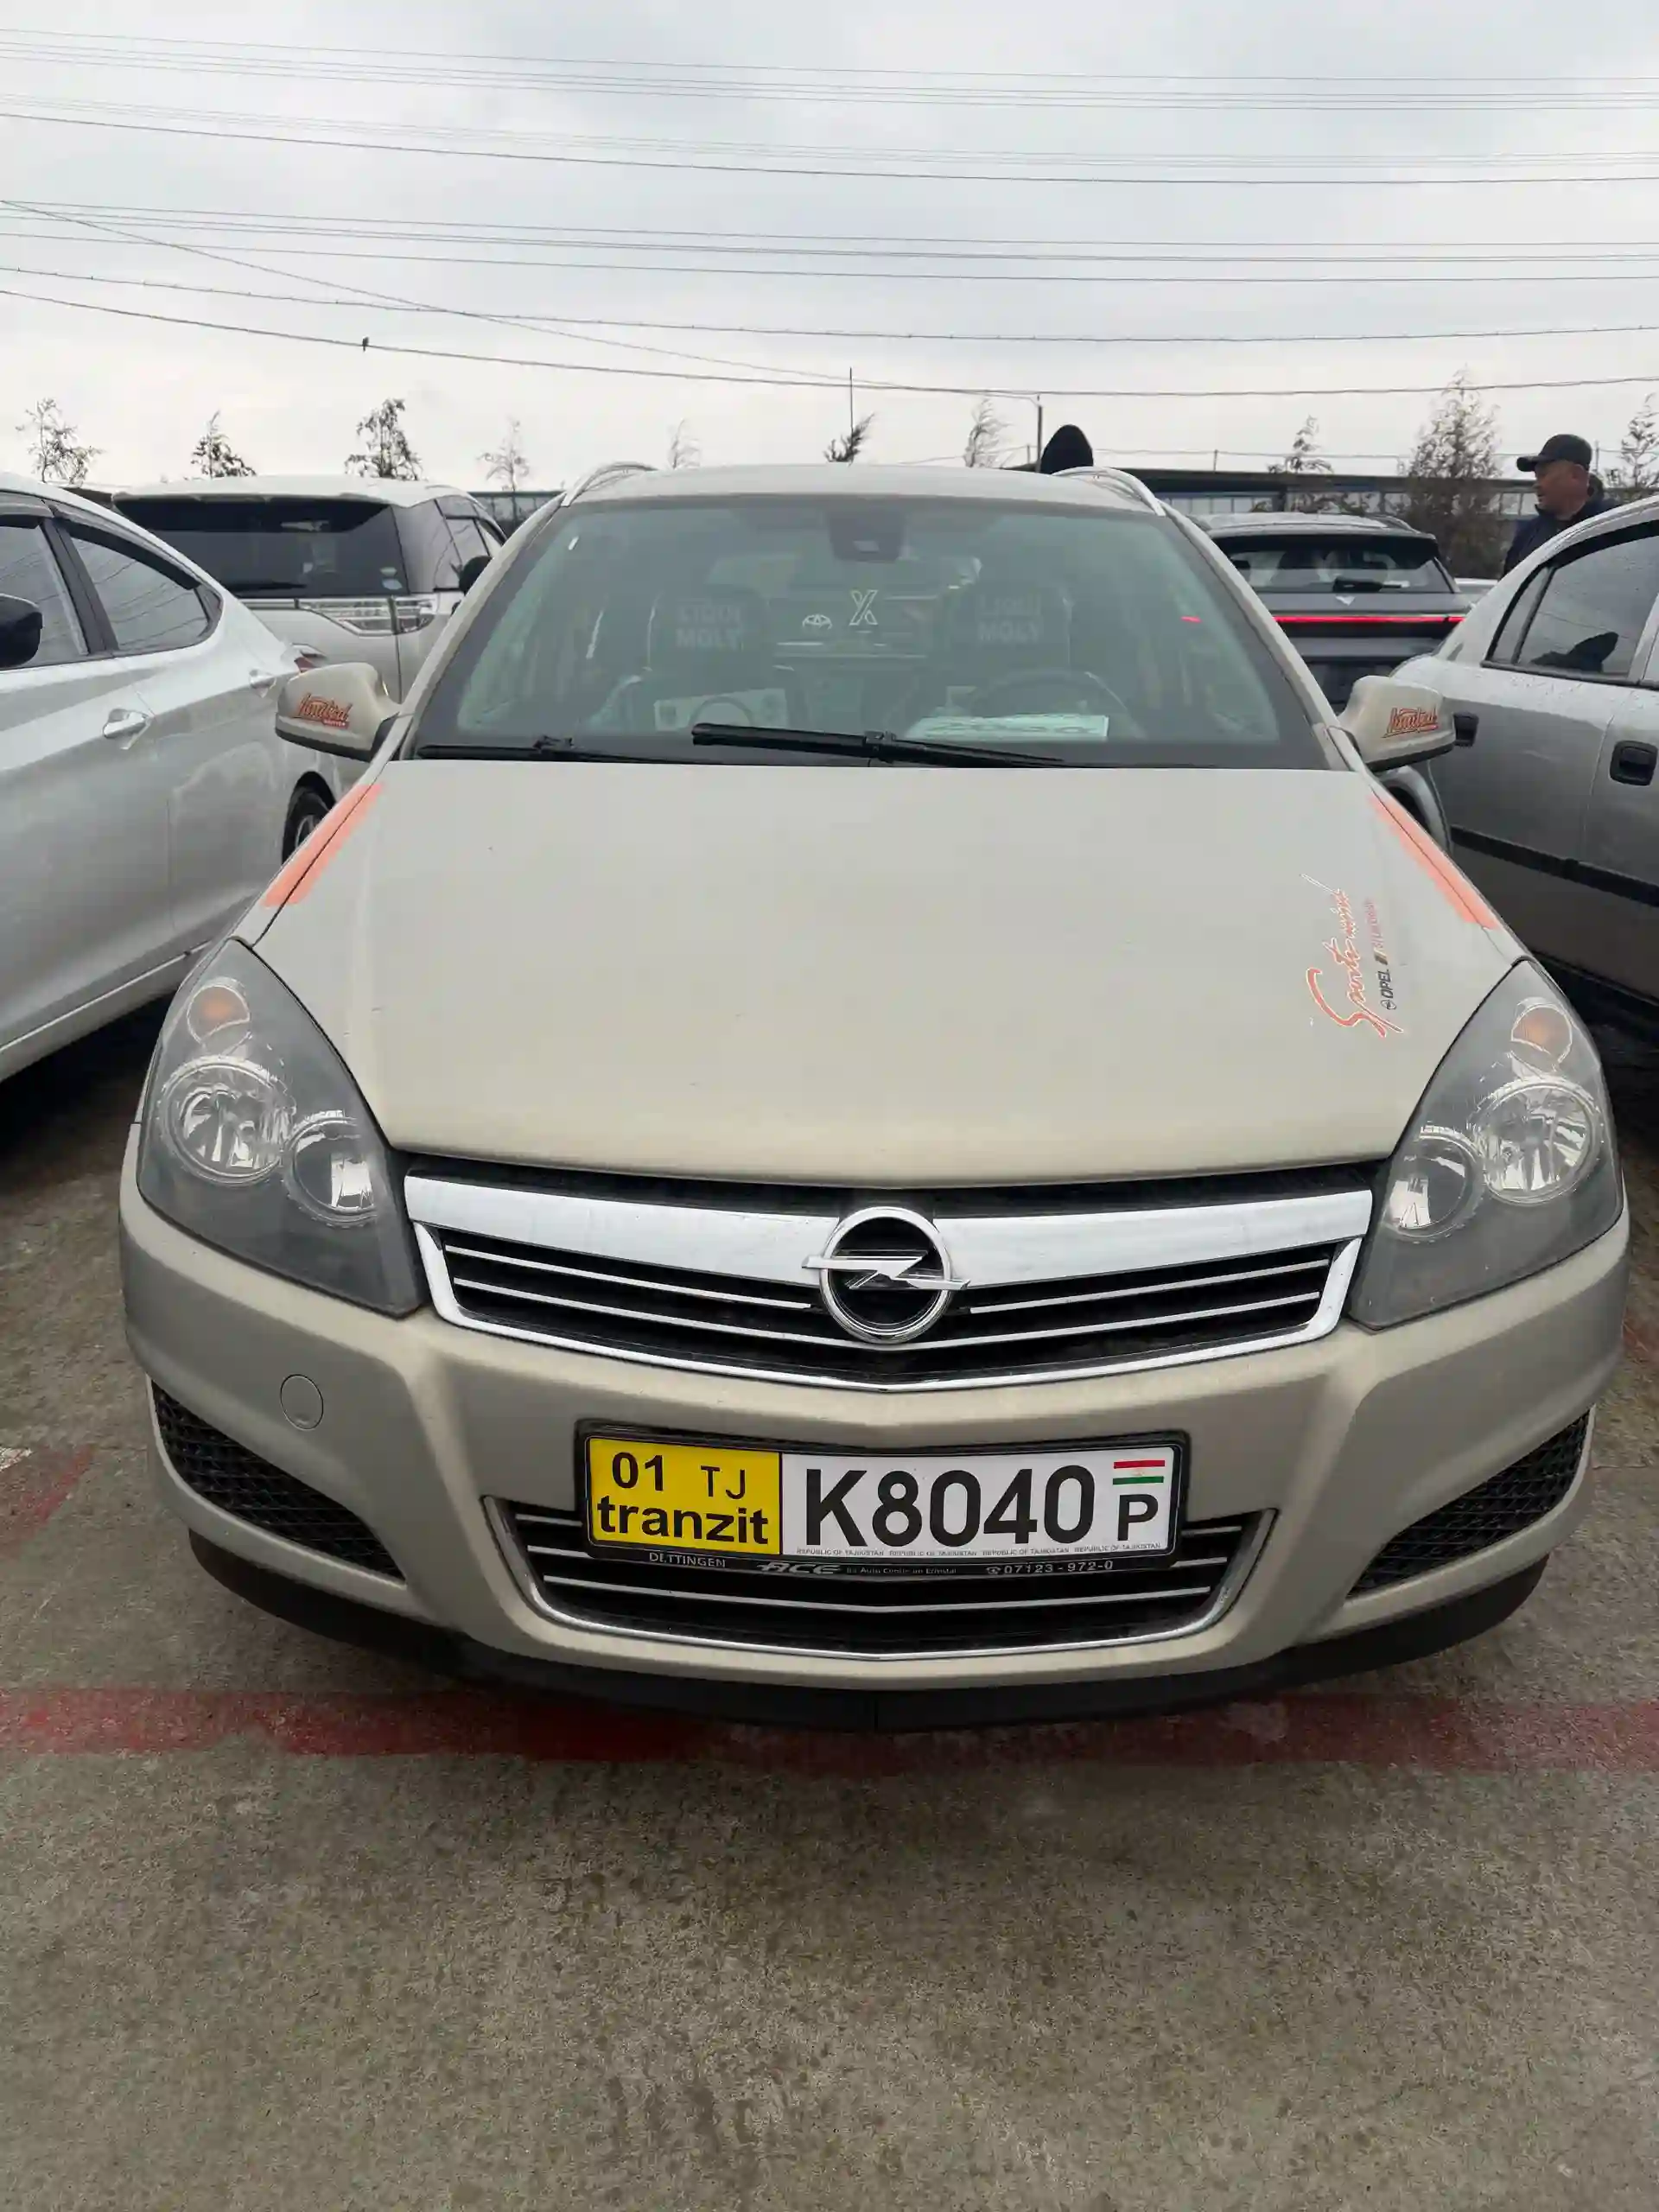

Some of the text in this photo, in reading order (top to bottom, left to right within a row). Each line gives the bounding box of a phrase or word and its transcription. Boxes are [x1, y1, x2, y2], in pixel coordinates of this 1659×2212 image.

[1377, 969, 1395, 1000] OPEL
[612, 1452, 746, 1500] 01 TJ
[596, 1495, 768, 1545] tranzit
[805, 1465, 1159, 1548] K8040 P
[649, 1552, 726, 1568] DETTINGEN
[757, 1561, 842, 1574] ACE
[860, 1566, 880, 1574] Auto
